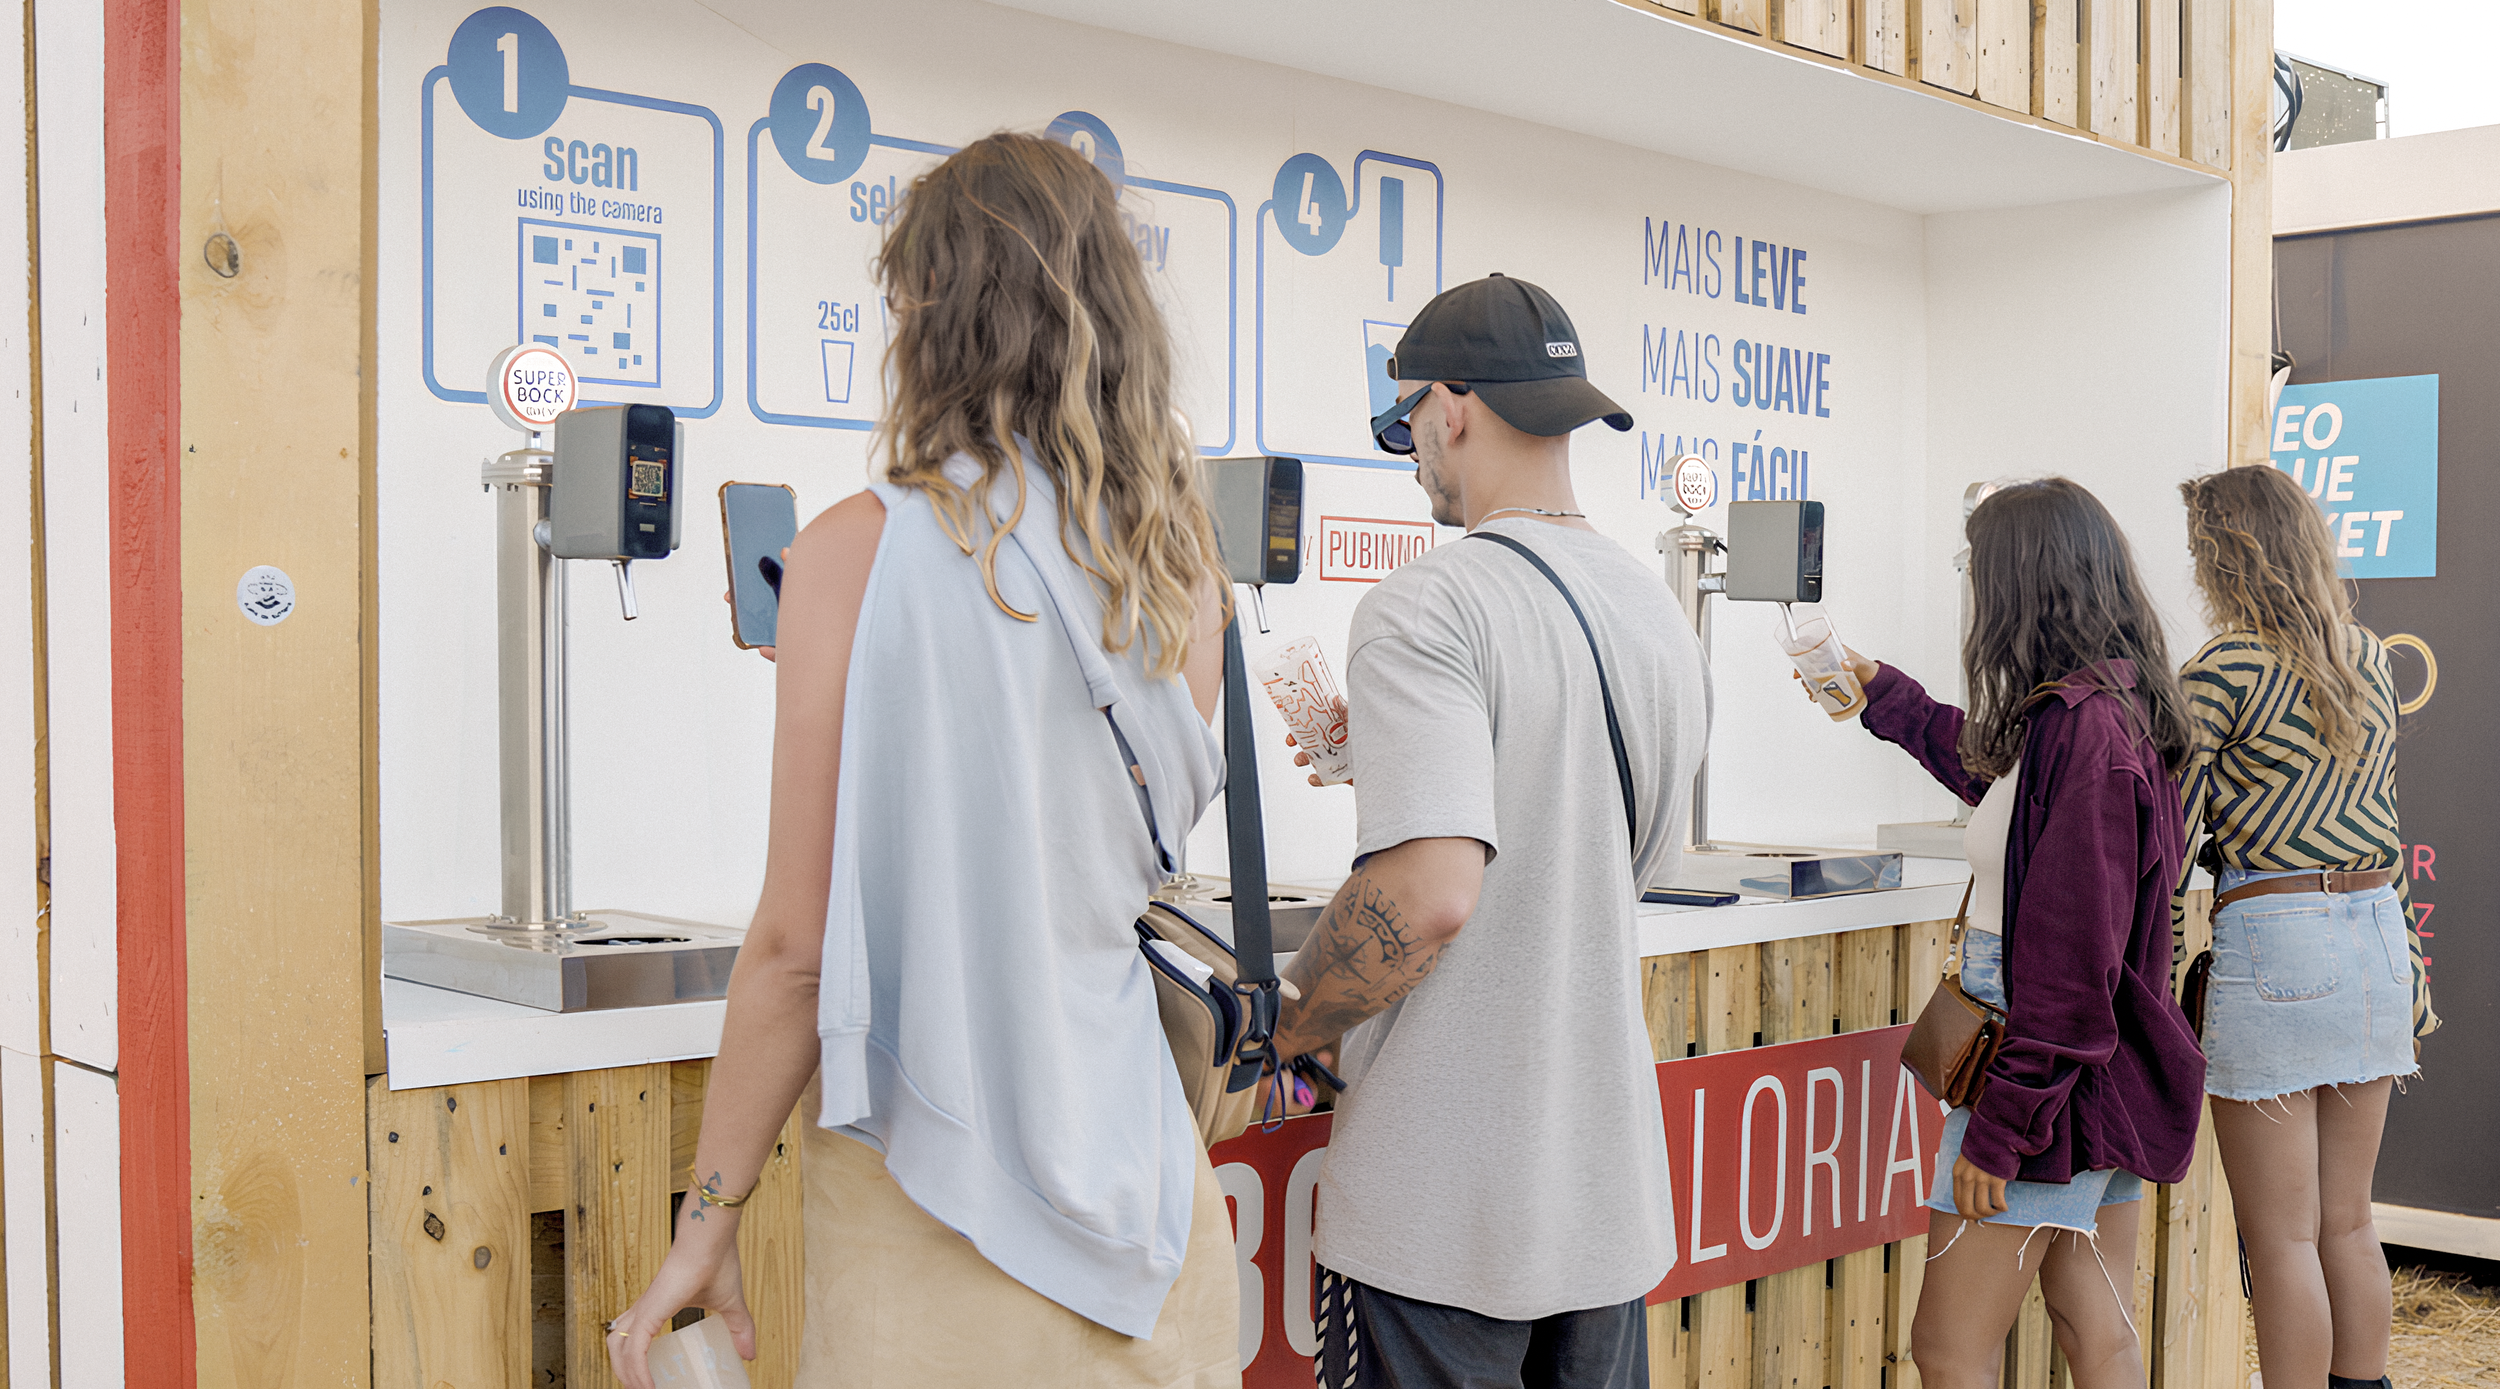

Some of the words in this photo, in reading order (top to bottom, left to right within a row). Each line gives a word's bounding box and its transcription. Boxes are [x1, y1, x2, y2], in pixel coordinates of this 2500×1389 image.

[496, 32, 519, 114] 1
[806, 85, 836, 162] 2
[543, 136, 638, 192] scan
[517, 186, 564, 217] using
[569, 191, 597, 217] the
[601, 198, 663, 225] camera
[1298, 171, 1323, 236] 4
[1644, 216, 1722, 299] MAIS
[1734, 235, 1807, 315] LEVE
[817, 301, 860, 333] 25cl
[513, 369, 567, 386] SUPER
[517, 387, 564, 404] BOCK
[1642, 323, 1721, 403] MAIS
[1732, 338, 1831, 418] SUAVE
